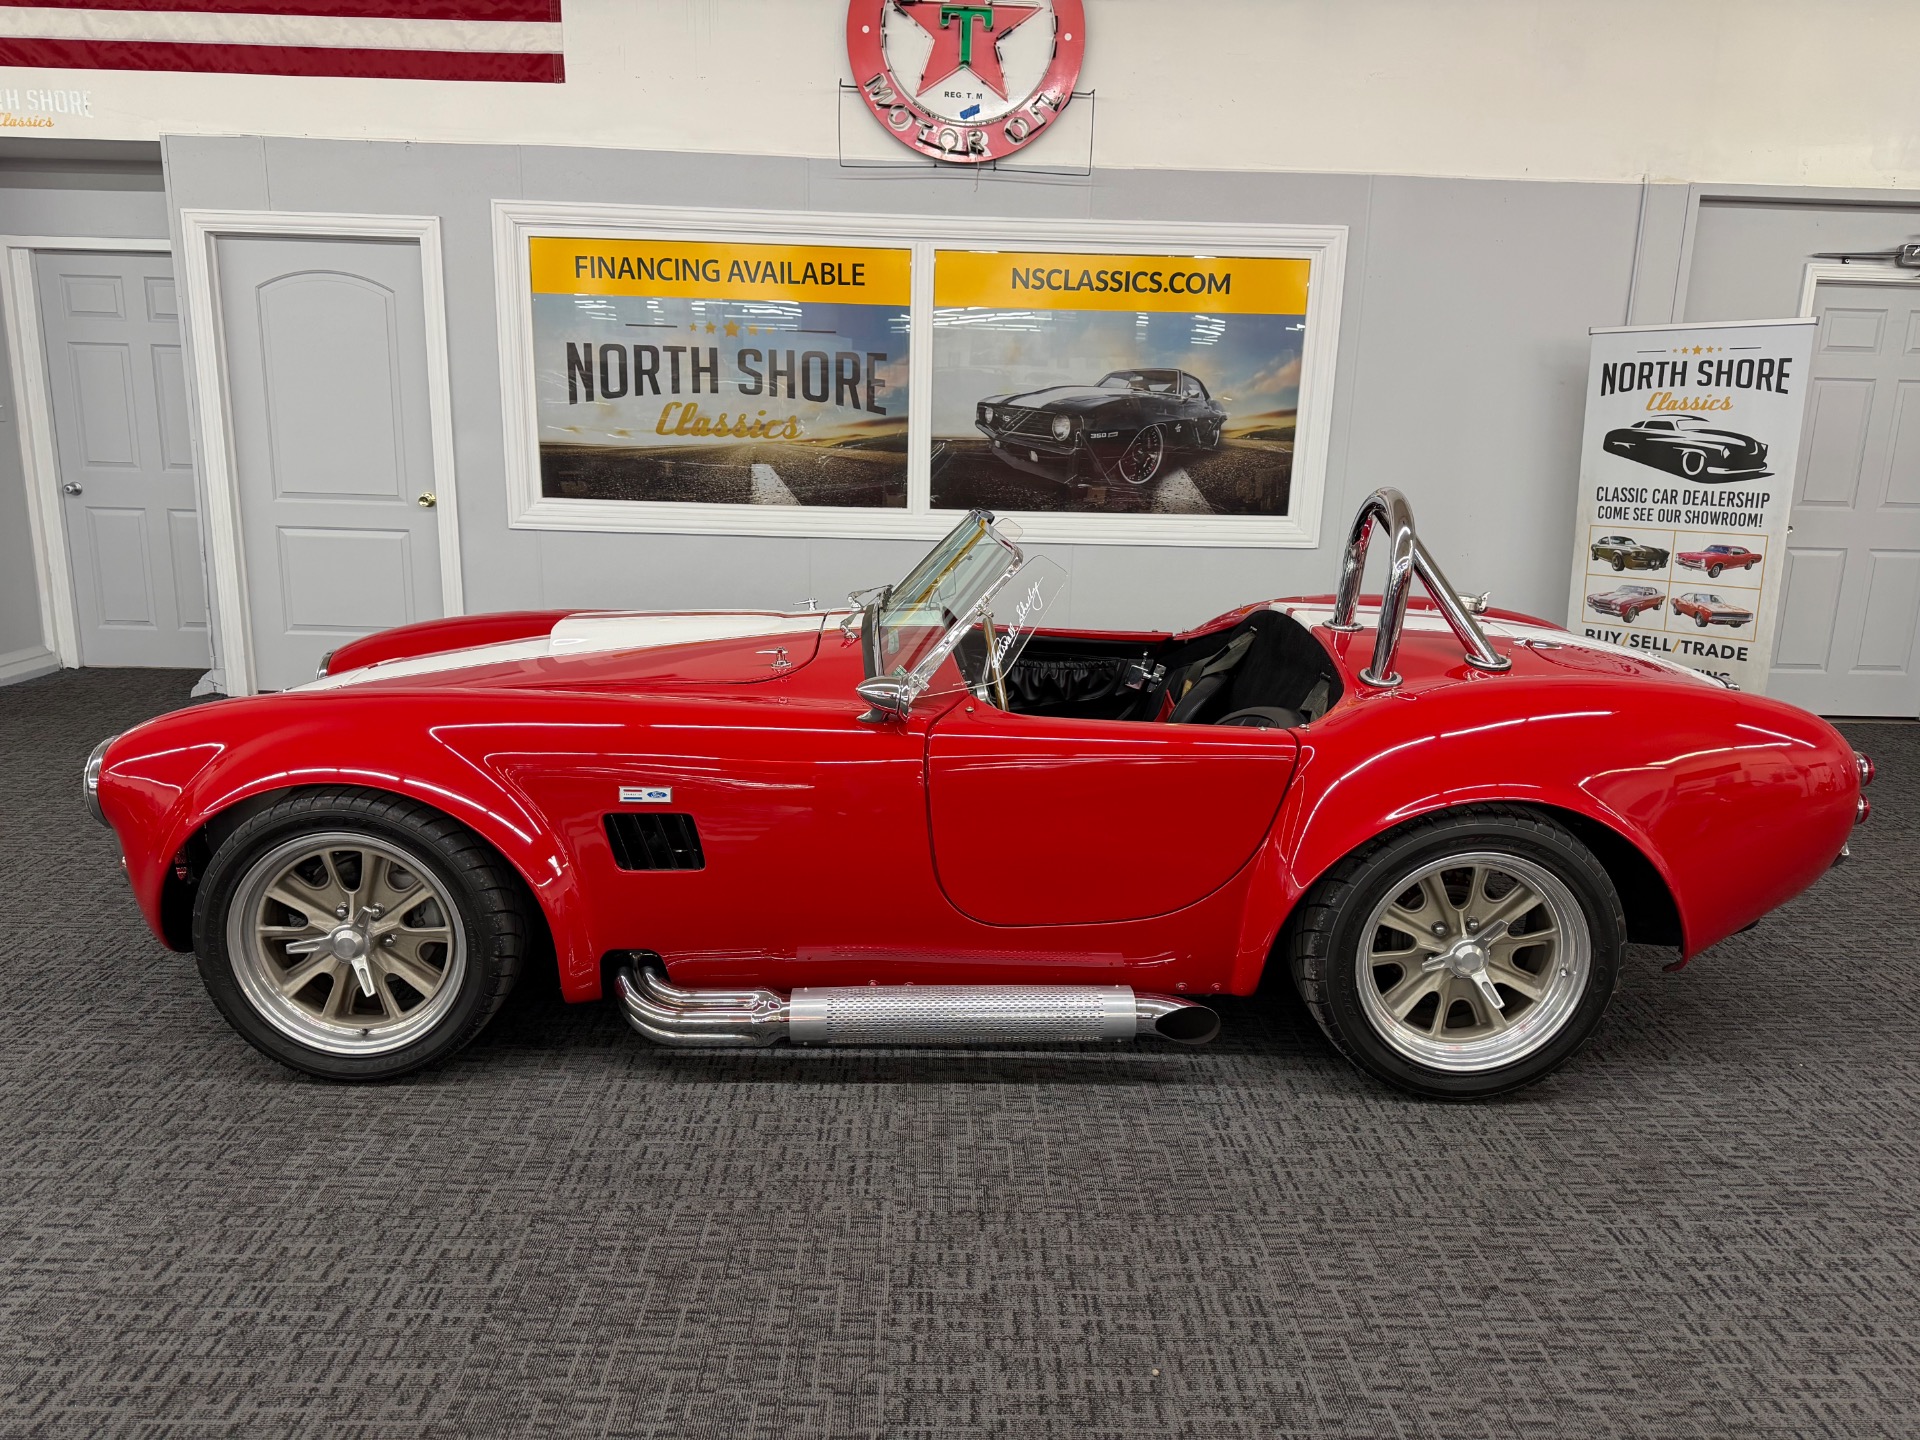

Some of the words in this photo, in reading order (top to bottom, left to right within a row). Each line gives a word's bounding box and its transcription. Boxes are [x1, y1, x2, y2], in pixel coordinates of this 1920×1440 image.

[26, 88, 95, 118] SHORE
[864, 72, 993, 158] MOTOR
[1004, 92, 1066, 146] OIL
[574, 255, 720, 283] FINANCING
[727, 259, 866, 286] AVAILABLE
[1011, 267, 1231, 295] NSCLASSICS.COM
[566, 342, 719, 405] NORTH
[737, 348, 887, 416] SHORE
[1601, 361, 1688, 397] NORTH
[1697, 358, 1793, 395] SHORE
[1645, 391, 1734, 412] Classics
[655, 401, 804, 440] Classics
[1596, 486, 1648, 504] CLASSIC
[1652, 488, 1679, 505] CAR
[1682, 489, 1771, 509] DEALERSHIP
[1597, 505, 1631, 521] COME
[1632, 507, 1655, 522] SEE
[1657, 508, 1682, 524] OUR
[1684, 509, 1764, 528] SHOWROOM!
